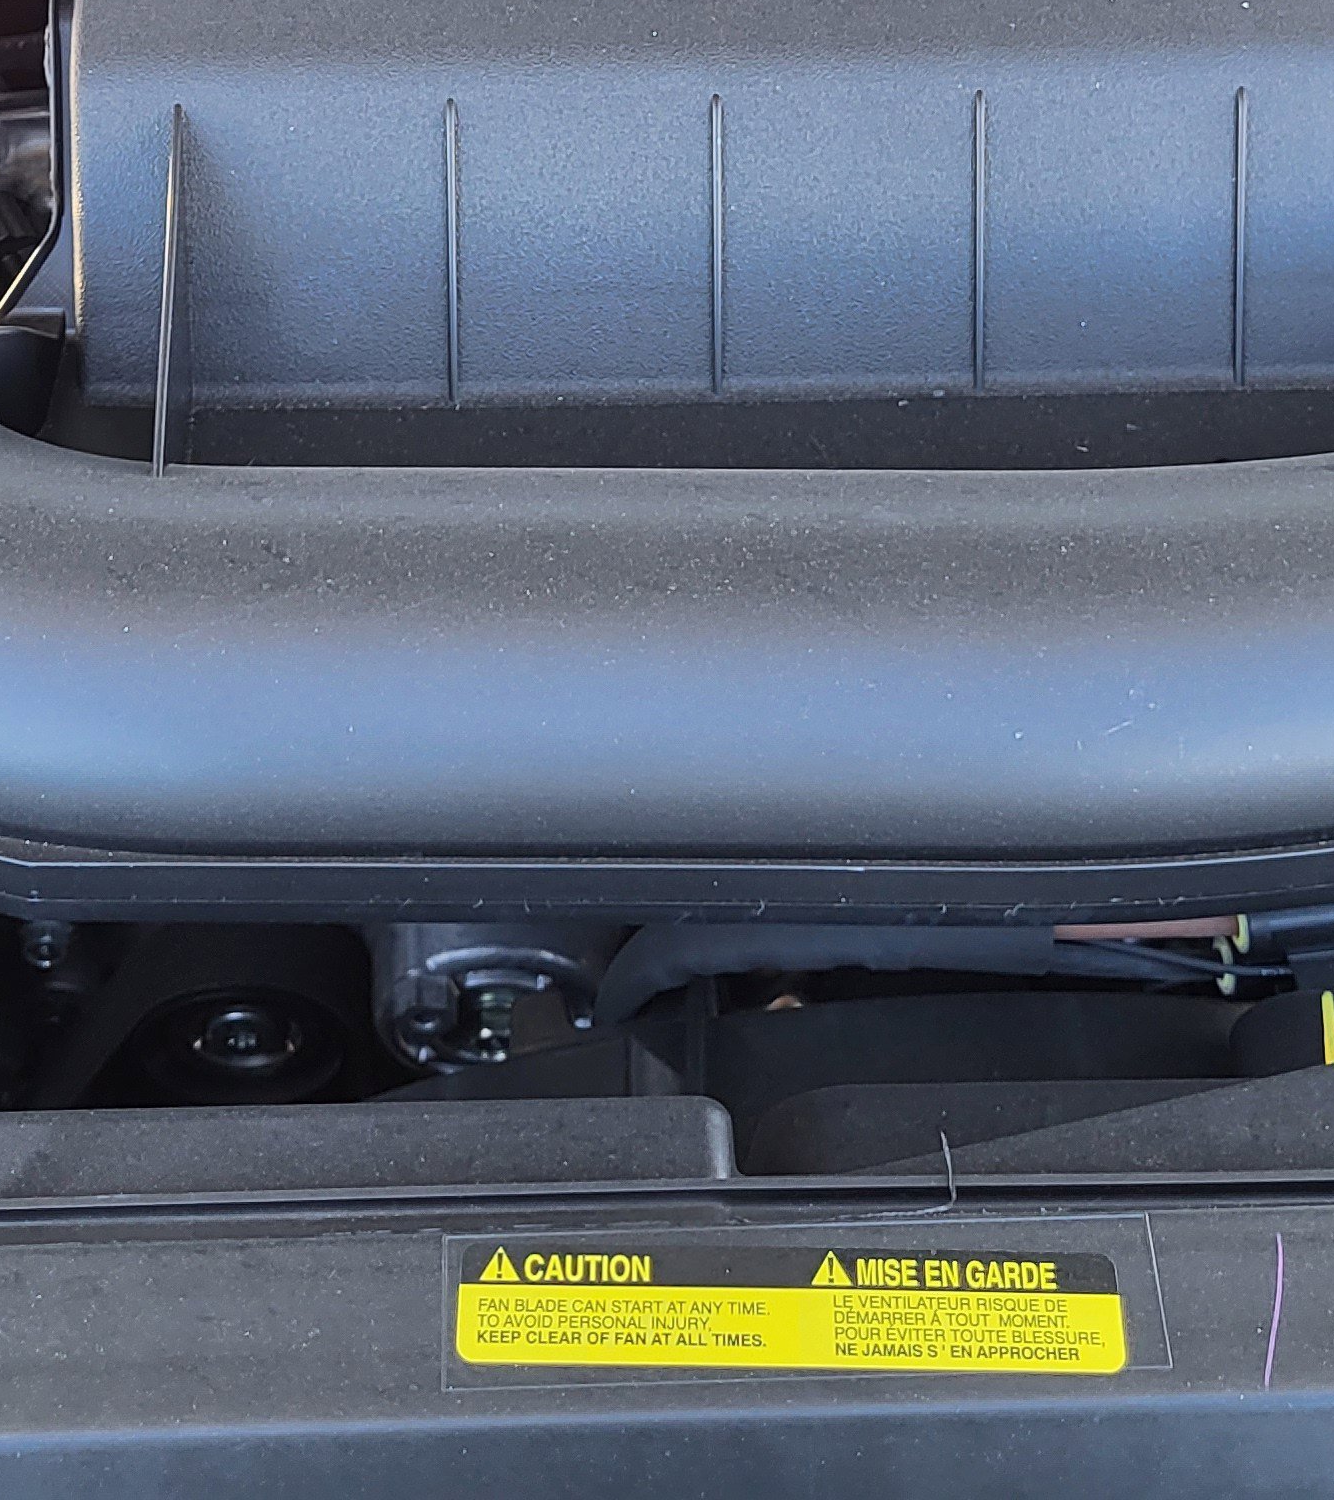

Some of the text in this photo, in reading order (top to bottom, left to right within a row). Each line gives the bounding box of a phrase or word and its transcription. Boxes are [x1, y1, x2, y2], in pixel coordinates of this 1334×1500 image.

[524, 1254, 652, 1283] CAUTION
[856, 1258, 1057, 1290] MISE EN GARDE
[478, 1298, 770, 1315] FAN BLADE CAN START AT ANY TIME.
[833, 1294, 1068, 1313] LE VENTILATEUR RISQUE DE
[478, 1314, 712, 1332] TO AVOID PERSONAL INJURY,
[834, 1306, 926, 1325] DÉMARRER
[946, 1313, 990, 1327] TOUT
[999, 1314, 1070, 1329] MOMENT.
[477, 1329, 767, 1348] KEEP CLEAR OF FAN AT ALL TIMES.
[835, 1322, 1106, 1347] POUR ÉVITER TOUTE BLESSURE,
[835, 1342, 858, 1356] NE
[862, 1343, 923, 1358] JAMAIS
[976, 1345, 1080, 1361] APPROCHER
